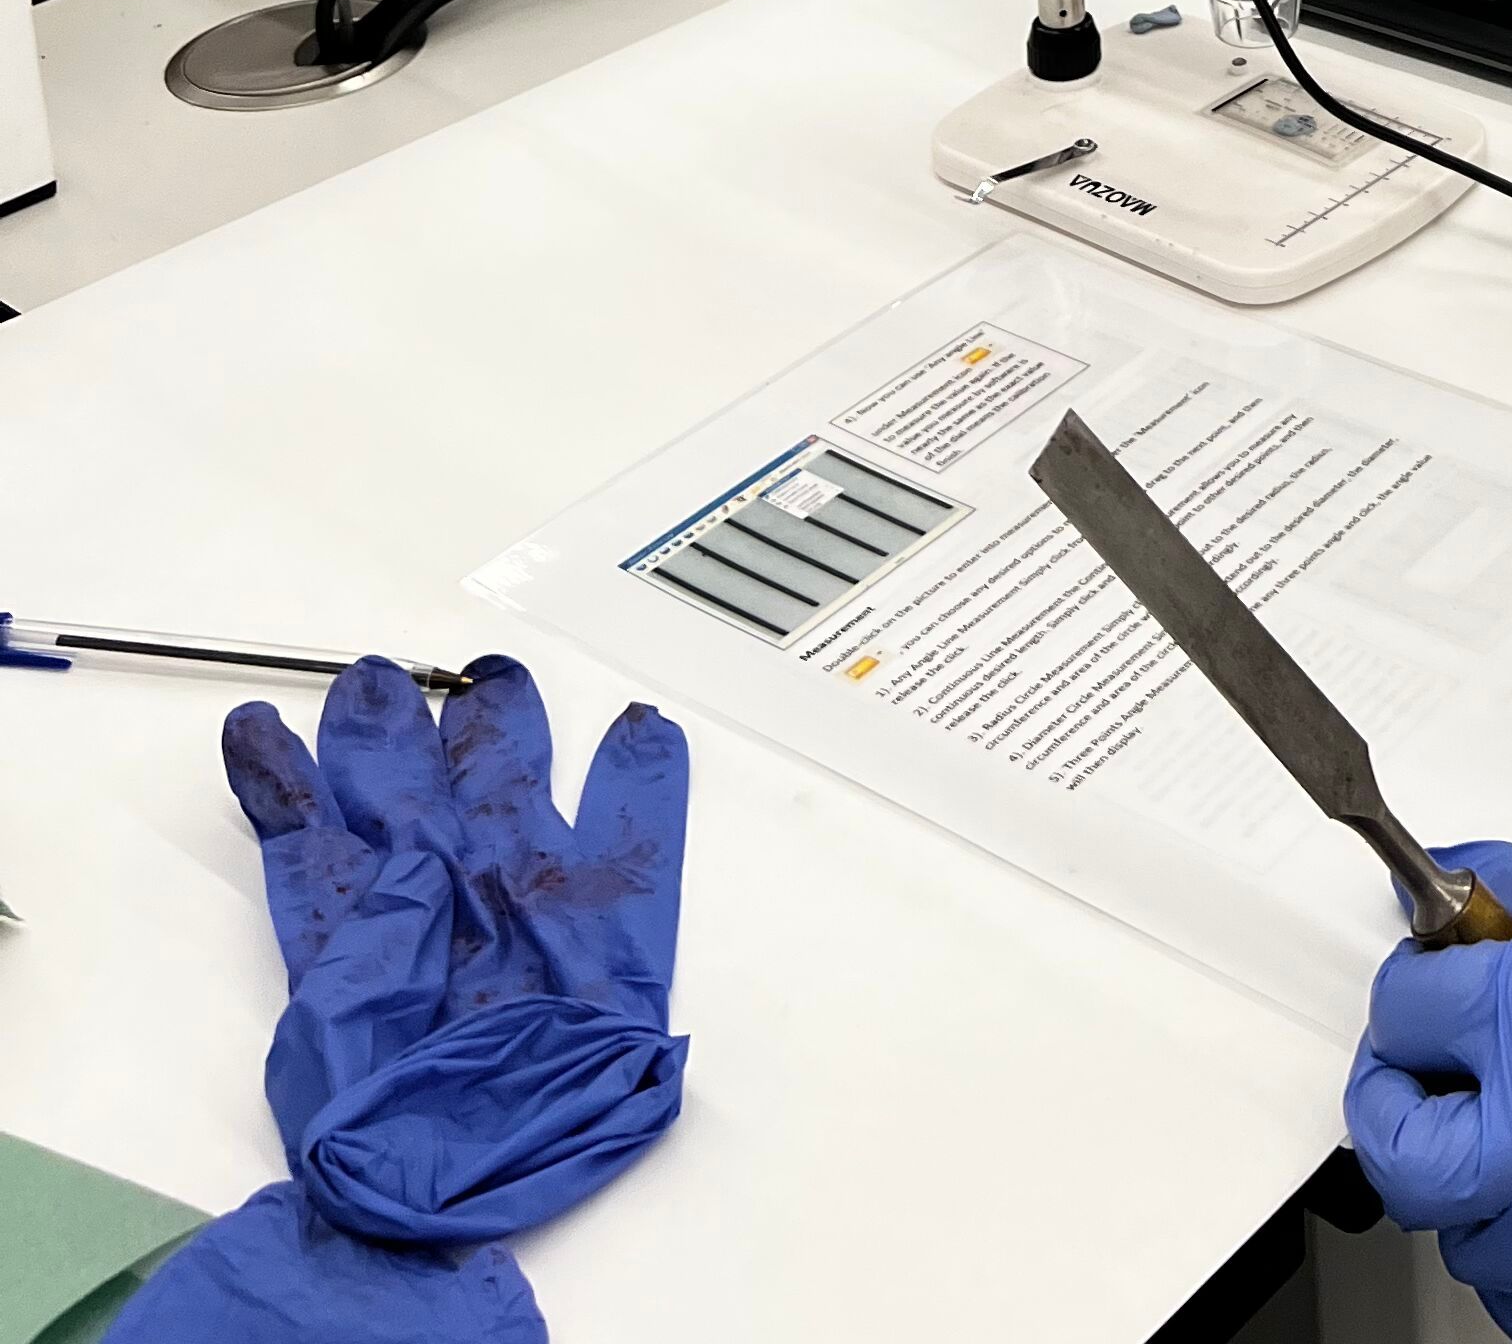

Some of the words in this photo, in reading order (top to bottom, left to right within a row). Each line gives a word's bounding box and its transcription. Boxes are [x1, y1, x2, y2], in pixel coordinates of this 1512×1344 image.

[799, 607, 874, 661] Measurement
[822, 629, 882, 672] Double-click
[881, 617, 897, 629] on
[894, 605, 913, 618] the
[912, 581, 946, 606] picture
[943, 572, 957, 581] to
[956, 553, 981, 573] enter
[980, 540, 1001, 554] into
[999, 500, 1052, 540] measureme
[1119, 437, 1136, 448] the
[1190, 382, 1210, 395] icon
[891, 670, 912, 686] Any
[911, 650, 939, 671] Angle
[936, 633, 959, 649] Line
[957, 586, 1020, 633] Measurement
[1018, 563, 1052, 586] Simply
[1049, 548, 1071, 564] click
[1145, 473, 1168, 489] drag
[1162, 466, 1176, 474] to
[1172, 455, 1190, 467] the
[1187, 441, 1208, 455] next
[1228, 411, 1245, 424] and
[1242, 398, 1263, 412] then
[901, 635, 921, 650] you
[920, 622, 939, 635] can
[938, 597, 972, 622] choose
[970, 583, 989, 597] any
[988, 558, 1021, 584] desired
[1020, 534, 1054, 559] options
[1051, 526, 1065, 534] to
[928, 663, 983, 704] Continuous
[981, 646, 1004, 662] Line
[1001, 598, 1065, 646] Measurement
[1062, 585, 1080, 598] the
[1078, 561, 1109, 586] Contin
[1167, 490, 1201, 517] urement
[1199, 470, 1225, 491] allows
[1223, 458, 1241, 471] you
[1237, 450, 1250, 459] to
[1248, 425, 1282, 451] measure
[1280, 413, 1297, 426] any
[930, 682, 984, 723] continuous
[982, 653, 1017, 681] desired
[1046, 605, 1080, 628] Simply
[1078, 590, 1099, 605] click
[1097, 574, 1115, 590] and
[1192, 504, 1205, 512] to
[1203, 486, 1226, 504] other
[1225, 462, 1256, 487] desired
[1279, 429, 1296, 443] and
[1293, 417, 1314, 431] then
[982, 705, 1017, 730] Radius
[1014, 683, 1043, 704] Circle
[1040, 632, 1104, 682] Measurement
[1101, 609, 1134, 633] Simply
[1210, 535, 1224, 544] to
[1220, 523, 1238, 536] the
[1236, 499, 1267, 524] desired
[1289, 467, 1306, 479] the
[1022, 714, 1067, 750] Diameter
[1065, 692, 1094, 713] Circle
[1091, 641, 1154, 692] Measurement
[1224, 563, 1248, 583] xtend
[1245, 551, 1263, 564] out
[1258, 543, 1272, 552] to
[1269, 531, 1286, 544] the
[1284, 506, 1314, 532] desired
[1347, 466, 1363, 477] the
[1062, 746, 1093, 769] Three
[1090, 722, 1123, 746] Points
[1120, 699, 1148, 722] Angle
[1145, 660, 1191, 699] Measurem
[1261, 588, 1279, 602] any
[1275, 569, 1300, 588] three
[1298, 548, 1325, 570] points
[1323, 530, 1345, 549] angle
[1344, 516, 1361, 530] and
[1376, 489, 1393, 500] the
[1391, 471, 1413, 489] angle
[1411, 454, 1432, 471] value
[891, 677, 927, 705] release
[925, 663, 944, 677] the
[945, 703, 981, 730] release
[979, 689, 999, 702] the
[985, 696, 1051, 750] circumference
[1051, 679, 1071, 696] and
[1069, 663, 1092, 681] area
[1090, 652, 1102, 663] of
[1099, 641, 1118, 654] the
[1117, 621, 1142, 641] circle
[1209, 542, 1240, 564] rdingly.
[1026, 715, 1091, 770] circumference
[1091, 698, 1110, 715] and
[1109, 681, 1131, 699] area
[1130, 670, 1142, 681] of
[1139, 659, 1158, 672] the
[1237, 559, 1278, 595] ccordingly.
[1066, 774, 1085, 790] will
[1083, 755, 1108, 775] then
